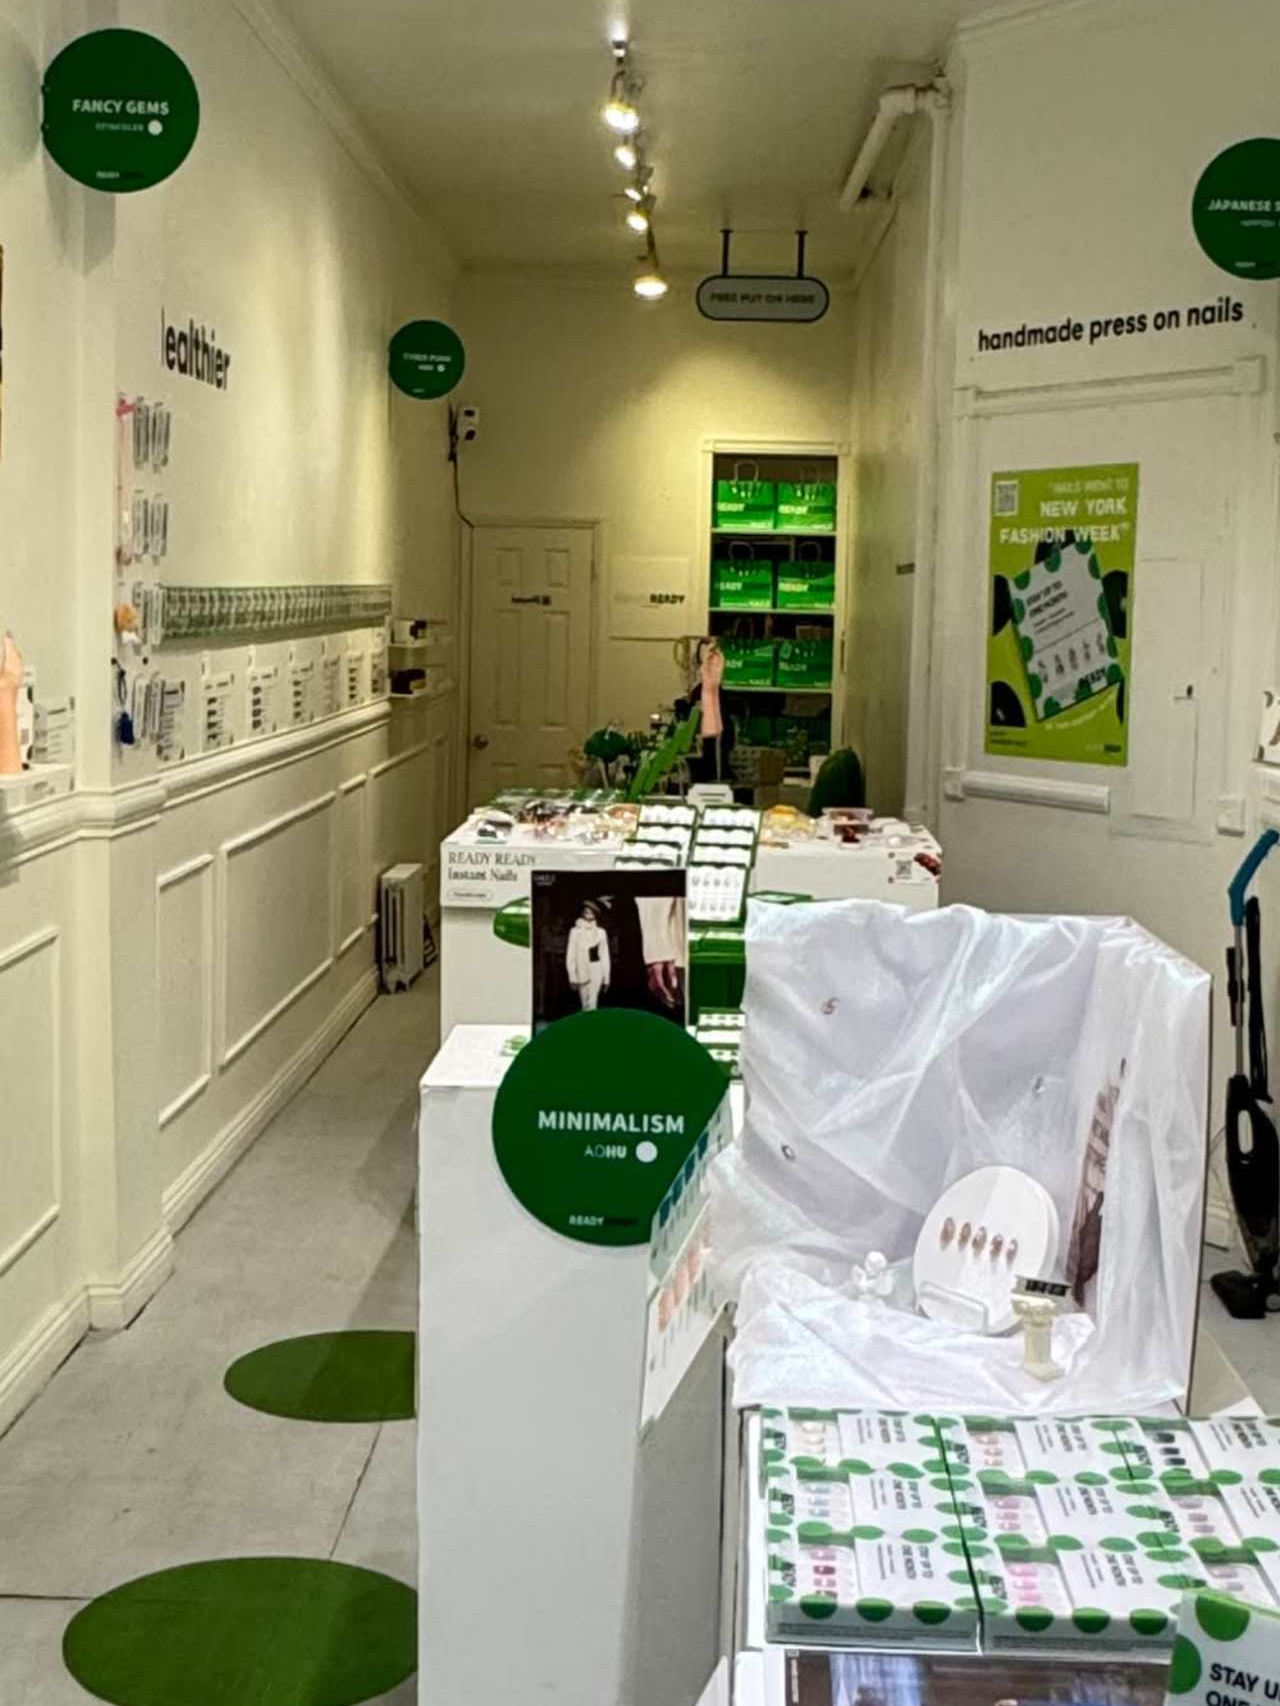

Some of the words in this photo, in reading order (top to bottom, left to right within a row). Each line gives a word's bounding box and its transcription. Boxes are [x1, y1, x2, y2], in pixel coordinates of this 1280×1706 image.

[72, 99, 123, 113] FANCY
[125, 100, 170, 115] GEMS
[1207, 199, 1271, 212] JAPANESE
[978, 318, 1083, 352] handmade
[1089, 312, 1147, 345] press
[1154, 307, 1181, 330] on
[1186, 297, 1244, 326] nails
[1040, 501, 1079, 518] NEW
[1086, 497, 1128, 514] YORK
[1000, 528, 1067, 543] FASHION
[448, 852, 492, 865] READY
[494, 853, 537, 867] READY
[448, 867, 488, 881] Instant
[489, 868, 518, 882] Nails
[537, 1109, 686, 1135] MINIMALISM
[568, 1214, 605, 1228] READY
[1209, 1662, 1260, 1694] STAY
